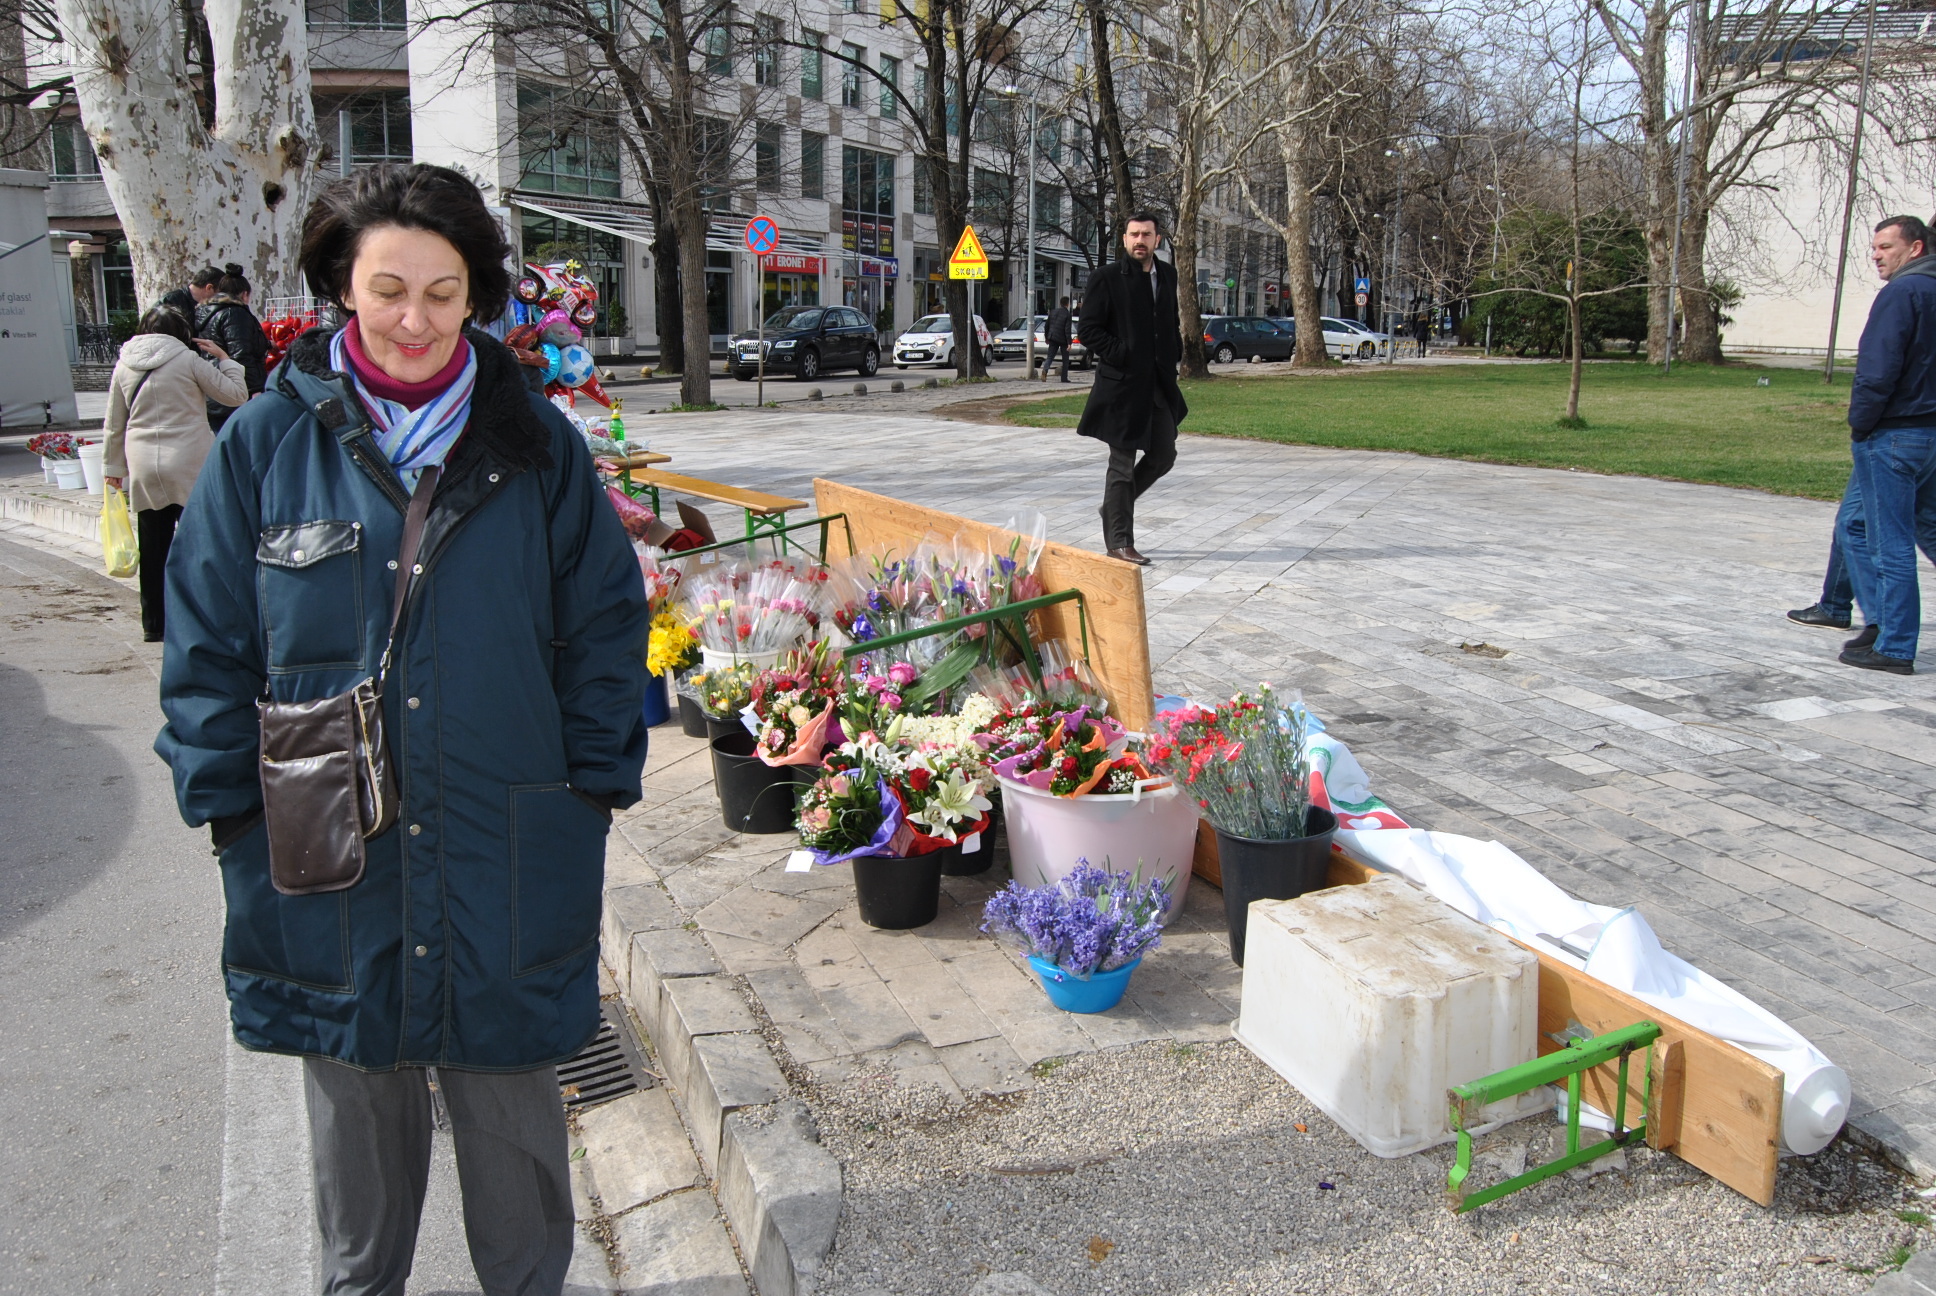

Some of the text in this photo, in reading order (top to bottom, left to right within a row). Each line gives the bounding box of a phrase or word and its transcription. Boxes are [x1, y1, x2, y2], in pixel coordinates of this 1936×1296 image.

[777, 256, 806, 268] ERONET
[7, 292, 31, 303] glass!
[1358, 296, 1365, 304] 30
